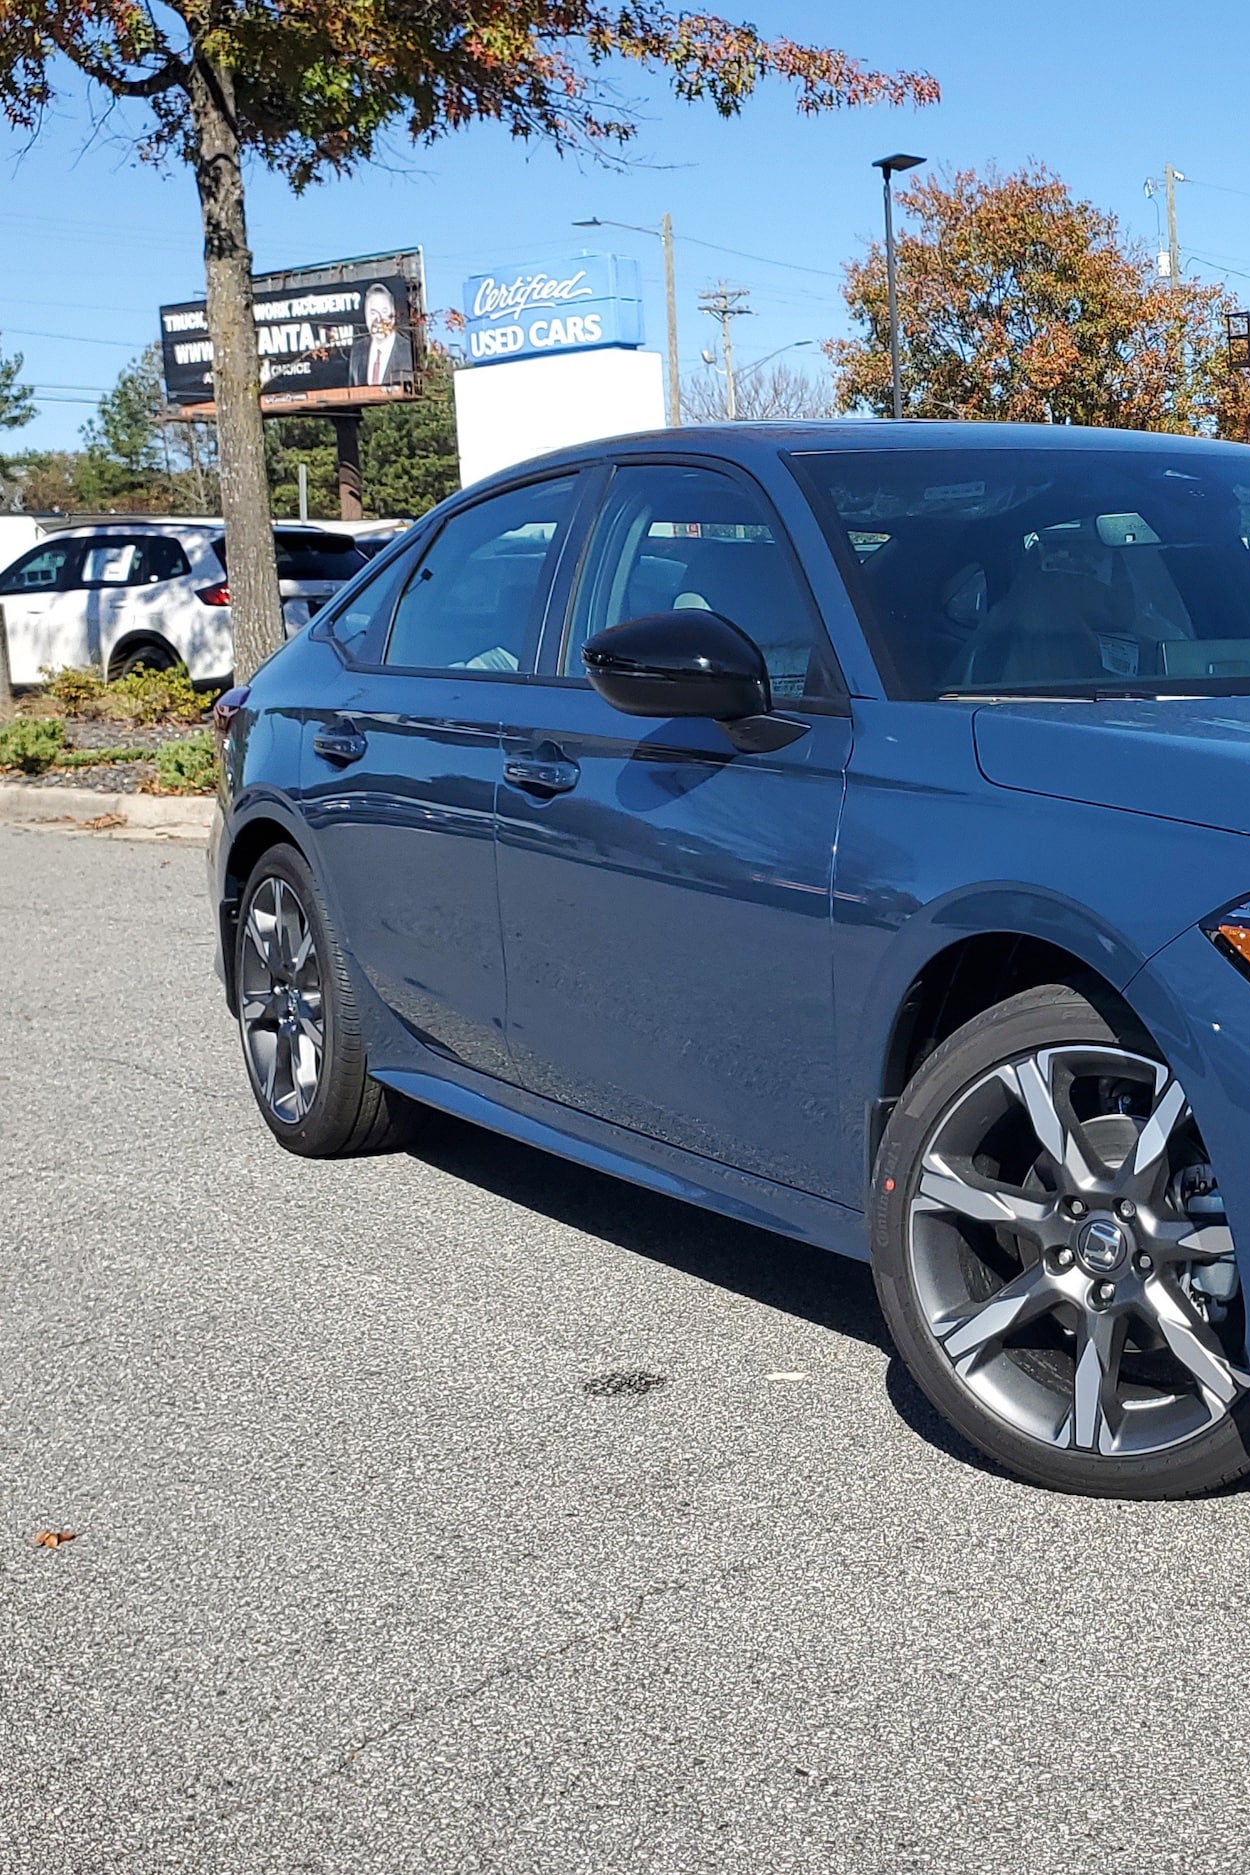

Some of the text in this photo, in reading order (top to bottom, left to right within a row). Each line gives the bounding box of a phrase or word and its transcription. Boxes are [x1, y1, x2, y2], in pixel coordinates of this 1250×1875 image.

[252, 301, 291, 322] WORK
[291, 292, 361, 317] ACCIDENT?
[474, 270, 593, 320] Certified
[470, 313, 602, 358] USED CARS
